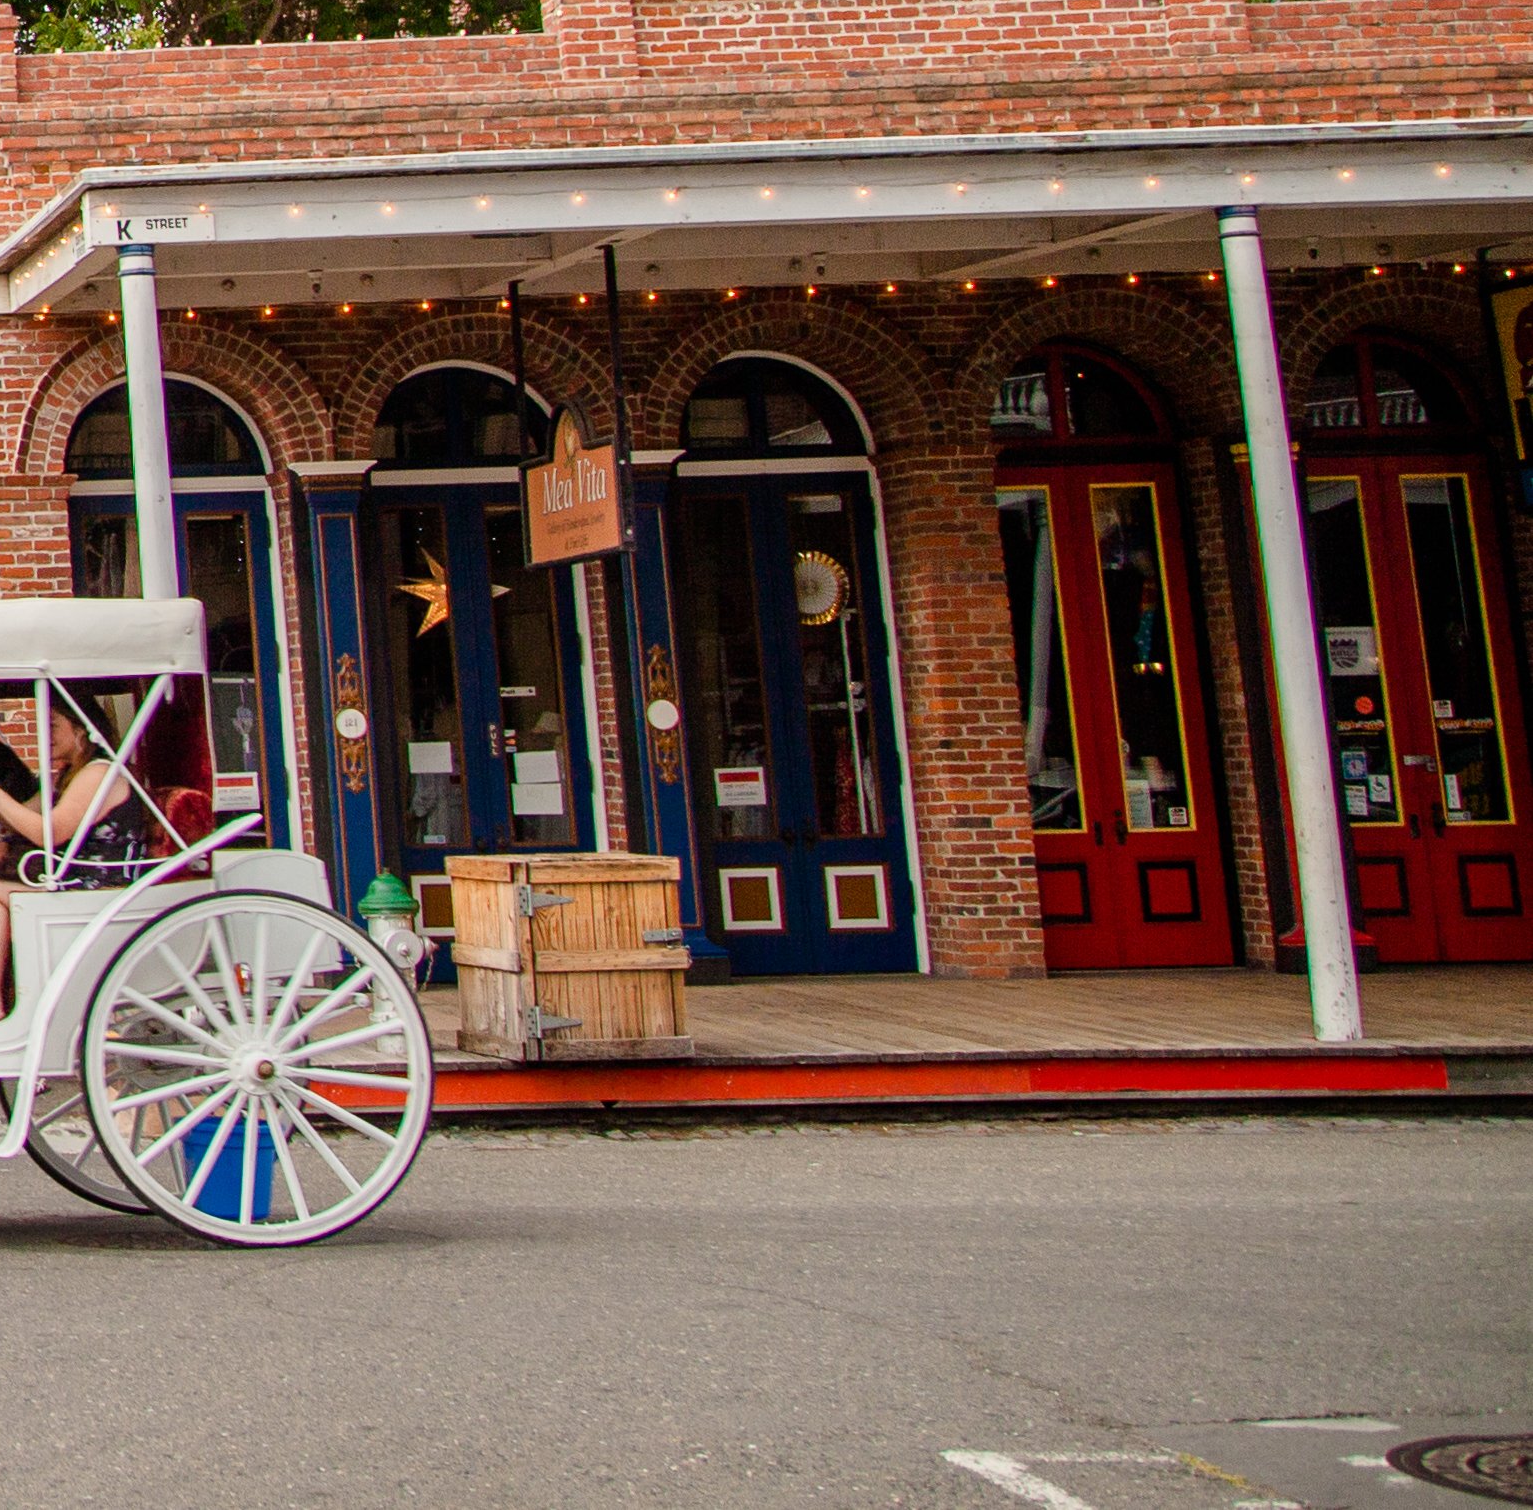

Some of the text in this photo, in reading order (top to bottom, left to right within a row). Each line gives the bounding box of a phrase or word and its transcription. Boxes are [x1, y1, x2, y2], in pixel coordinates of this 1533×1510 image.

[116, 217, 189, 241] K STREET
[542, 457, 607, 514] Mea Vita
